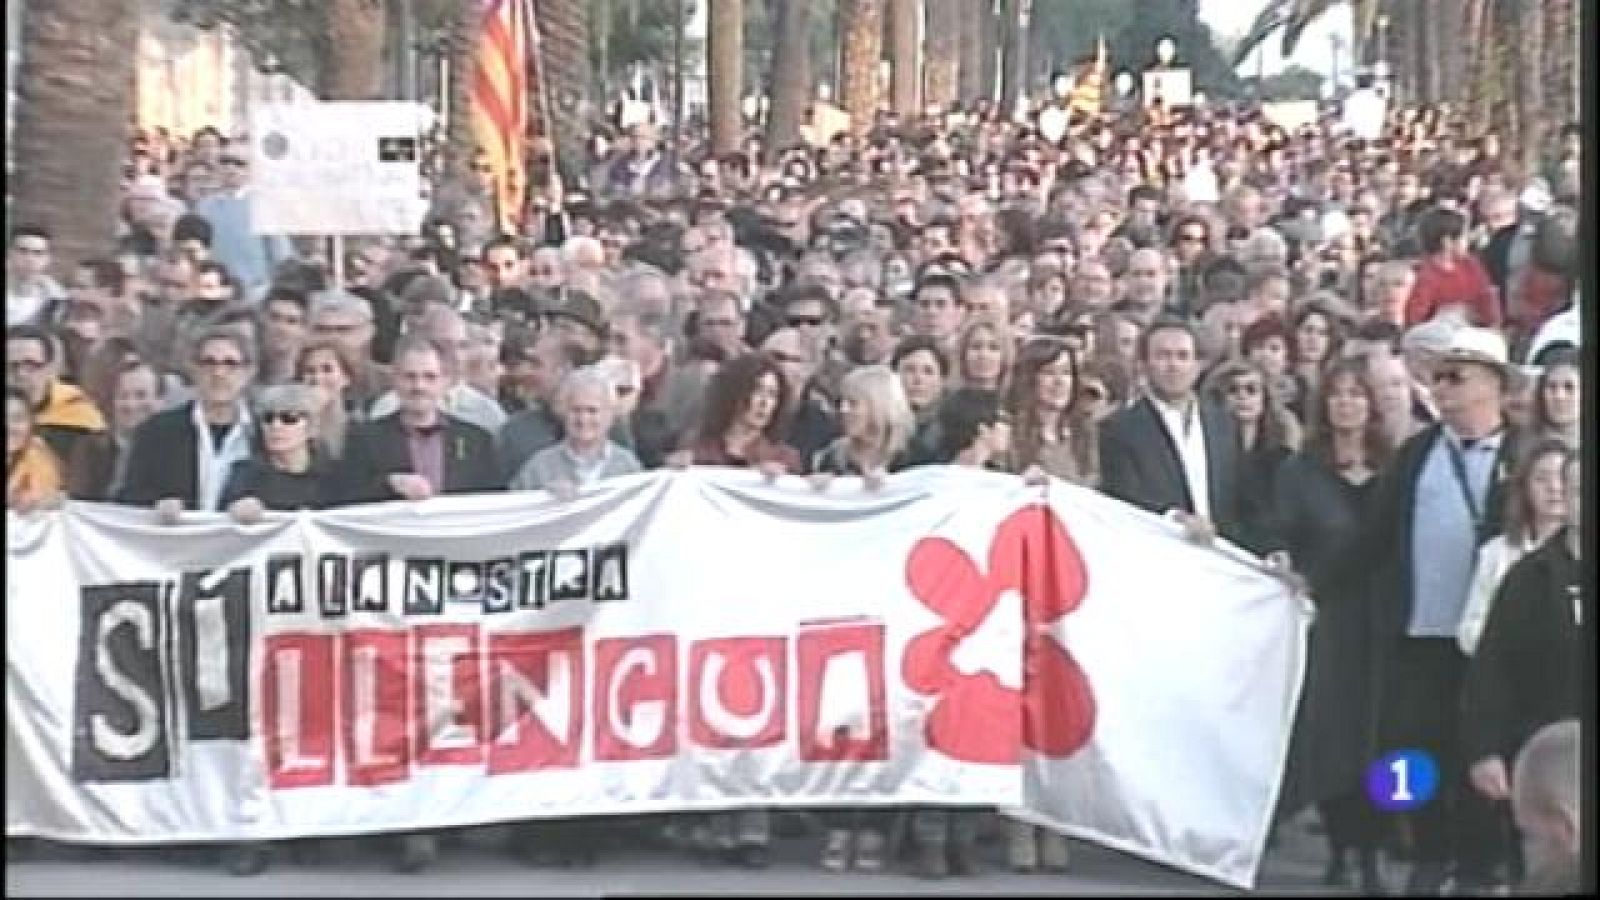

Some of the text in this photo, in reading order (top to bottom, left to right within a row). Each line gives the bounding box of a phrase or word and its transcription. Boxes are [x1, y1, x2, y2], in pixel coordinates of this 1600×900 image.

[269, 559, 299, 610] A
[406, 549, 625, 610] NOSTRA
[268, 626, 878, 778] LLENGUA
